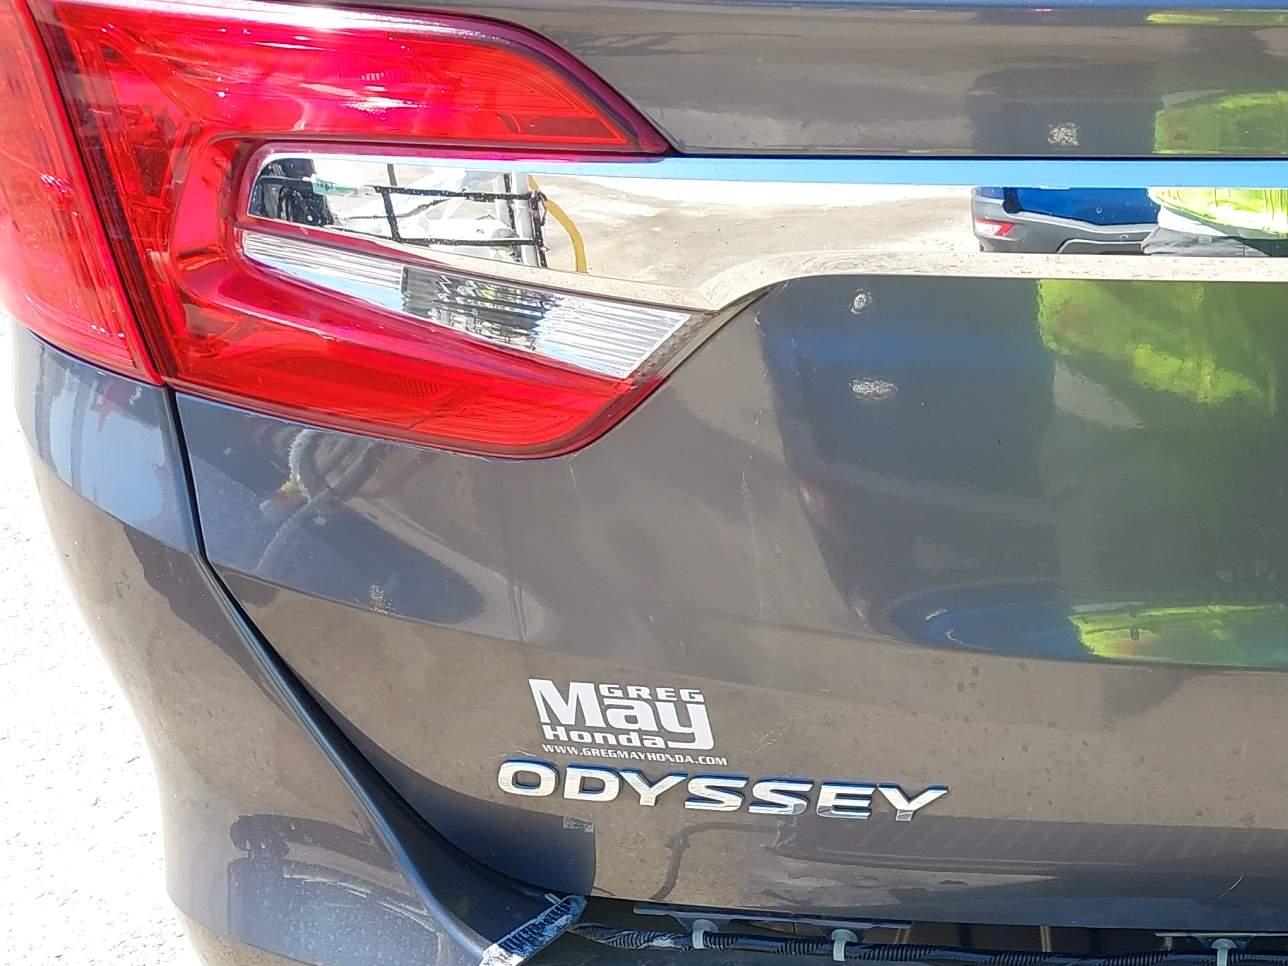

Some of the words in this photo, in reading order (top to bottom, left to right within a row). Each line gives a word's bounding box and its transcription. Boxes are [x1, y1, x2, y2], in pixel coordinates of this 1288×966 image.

[598, 684, 704, 703] GREG
[528, 678, 715, 750] May
[542, 724, 666, 749] Honda
[541, 743, 729, 767] WWW.GREGMAYHONDA.COM
[496, 758, 950, 823] ODYSSEY
